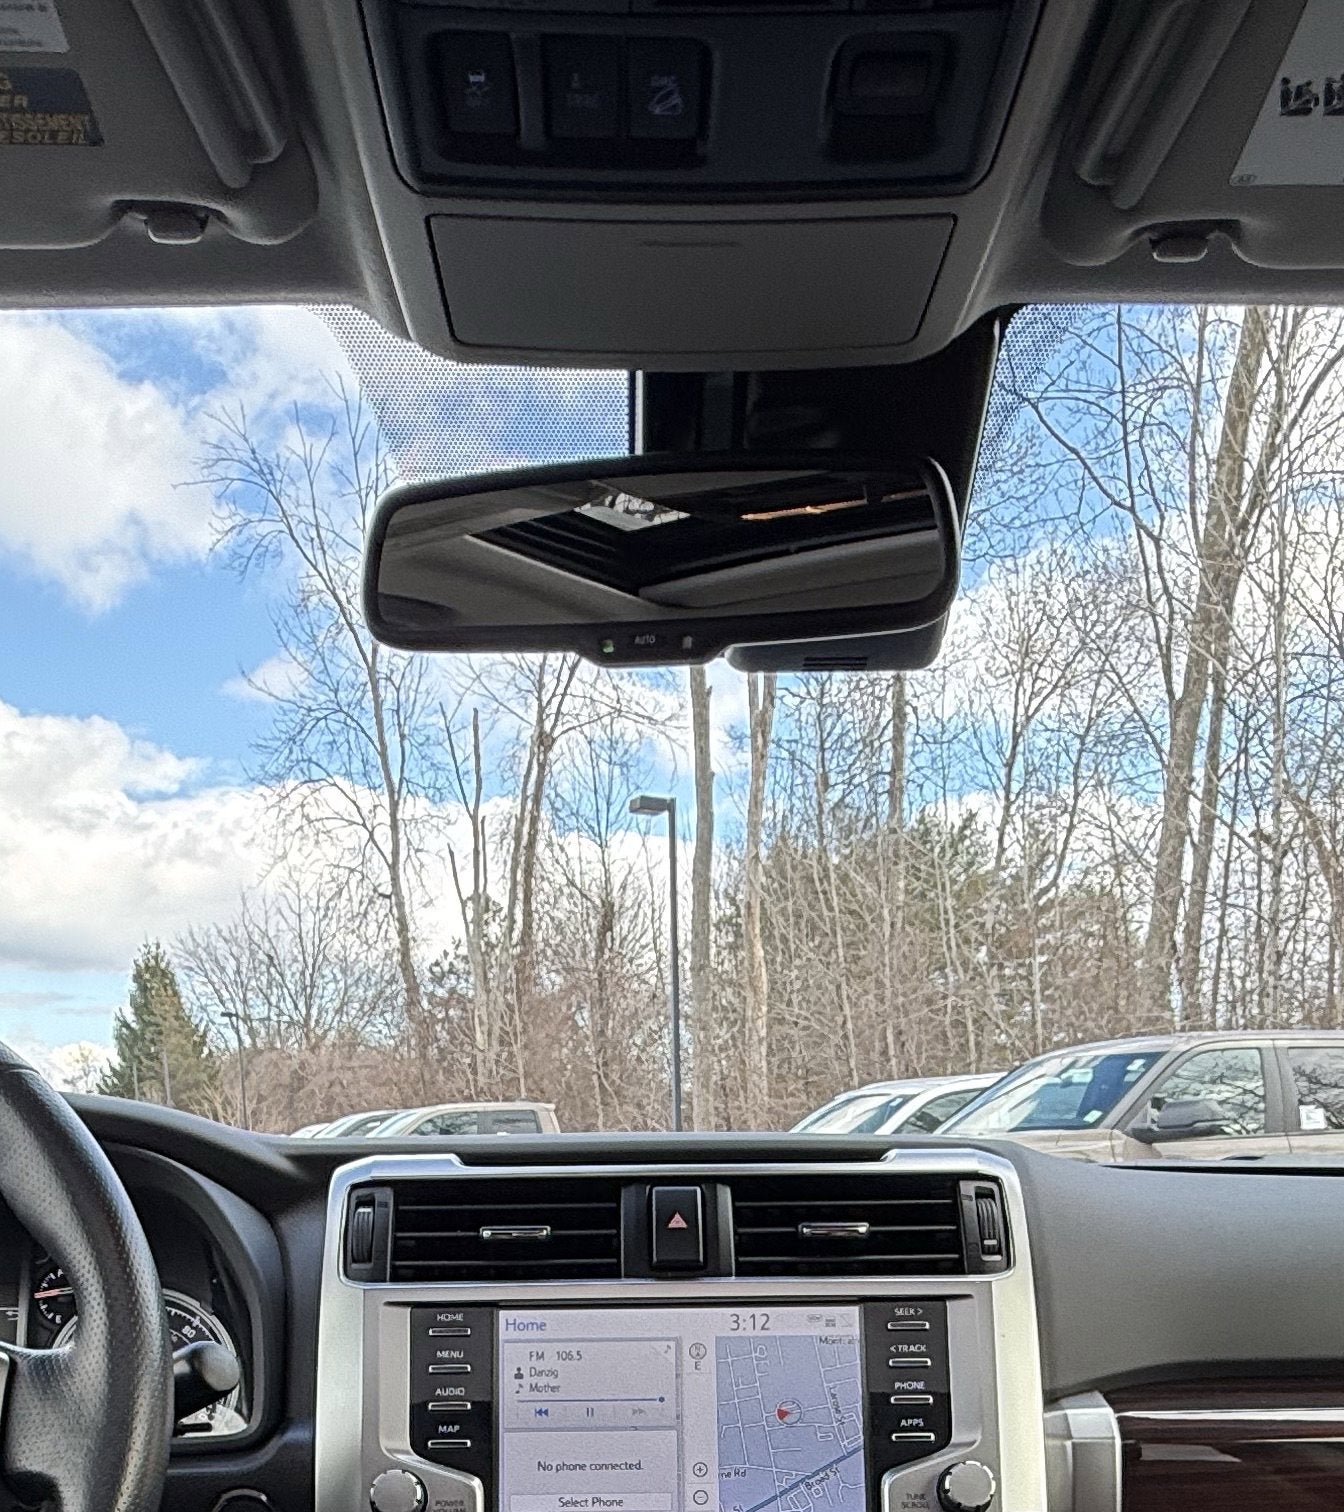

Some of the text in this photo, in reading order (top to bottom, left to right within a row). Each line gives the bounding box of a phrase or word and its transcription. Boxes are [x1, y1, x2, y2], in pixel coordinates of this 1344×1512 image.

[437, 1313, 464, 1322] HOME
[729, 1313, 771, 1331] 3:12
[505, 1318, 547, 1332] Home
[897, 1344, 927, 1352] TRACK
[436, 1351, 464, 1359] MENU
[529, 1350, 583, 1361] FM 106.5
[529, 1367, 559, 1379] Danzig
[529, 1382, 560, 1393] Mother
[894, 1381, 925, 1390] PHONE
[435, 1387, 465, 1396] AUDIO
[900, 1419, 925, 1428] APPS
[438, 1425, 460, 1433] MAP
[537, 1460, 644, 1474] No phone connected.
[558, 1496, 624, 1508] Select Phone
